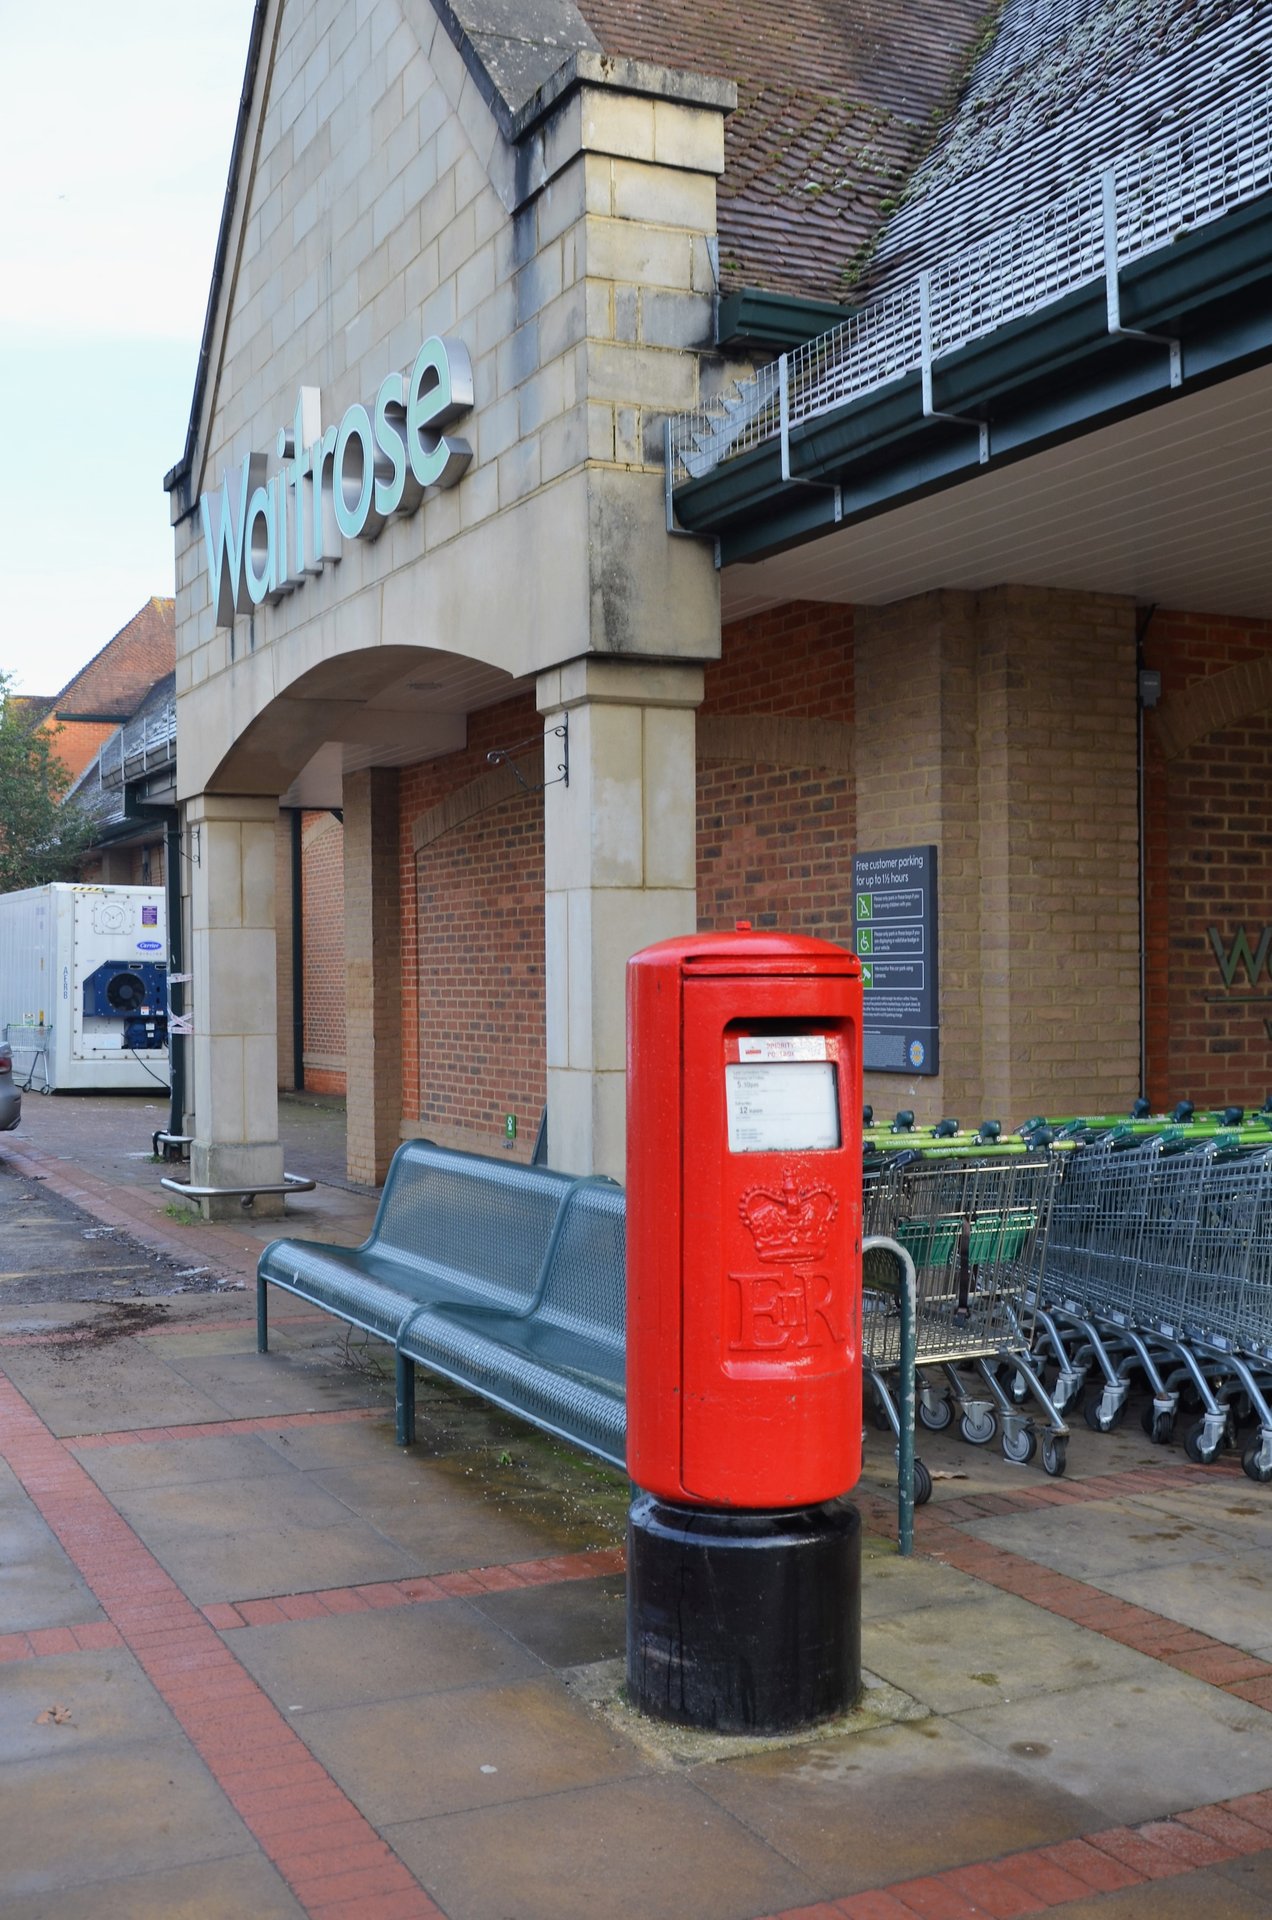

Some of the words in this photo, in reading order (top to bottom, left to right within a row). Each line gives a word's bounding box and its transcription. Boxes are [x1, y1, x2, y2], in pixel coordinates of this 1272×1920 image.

[200, 335, 468, 628] Waitrose
[856, 861, 869, 871] Free
[870, 858, 897, 869] customer
[899, 855, 923, 870] parking
[856, 876, 865, 886] for
[866, 877, 873, 887] up
[875, 875, 881, 884] to
[891, 872, 909, 883] hours
[1215, 1126, 1245, 1135] Waitrose
